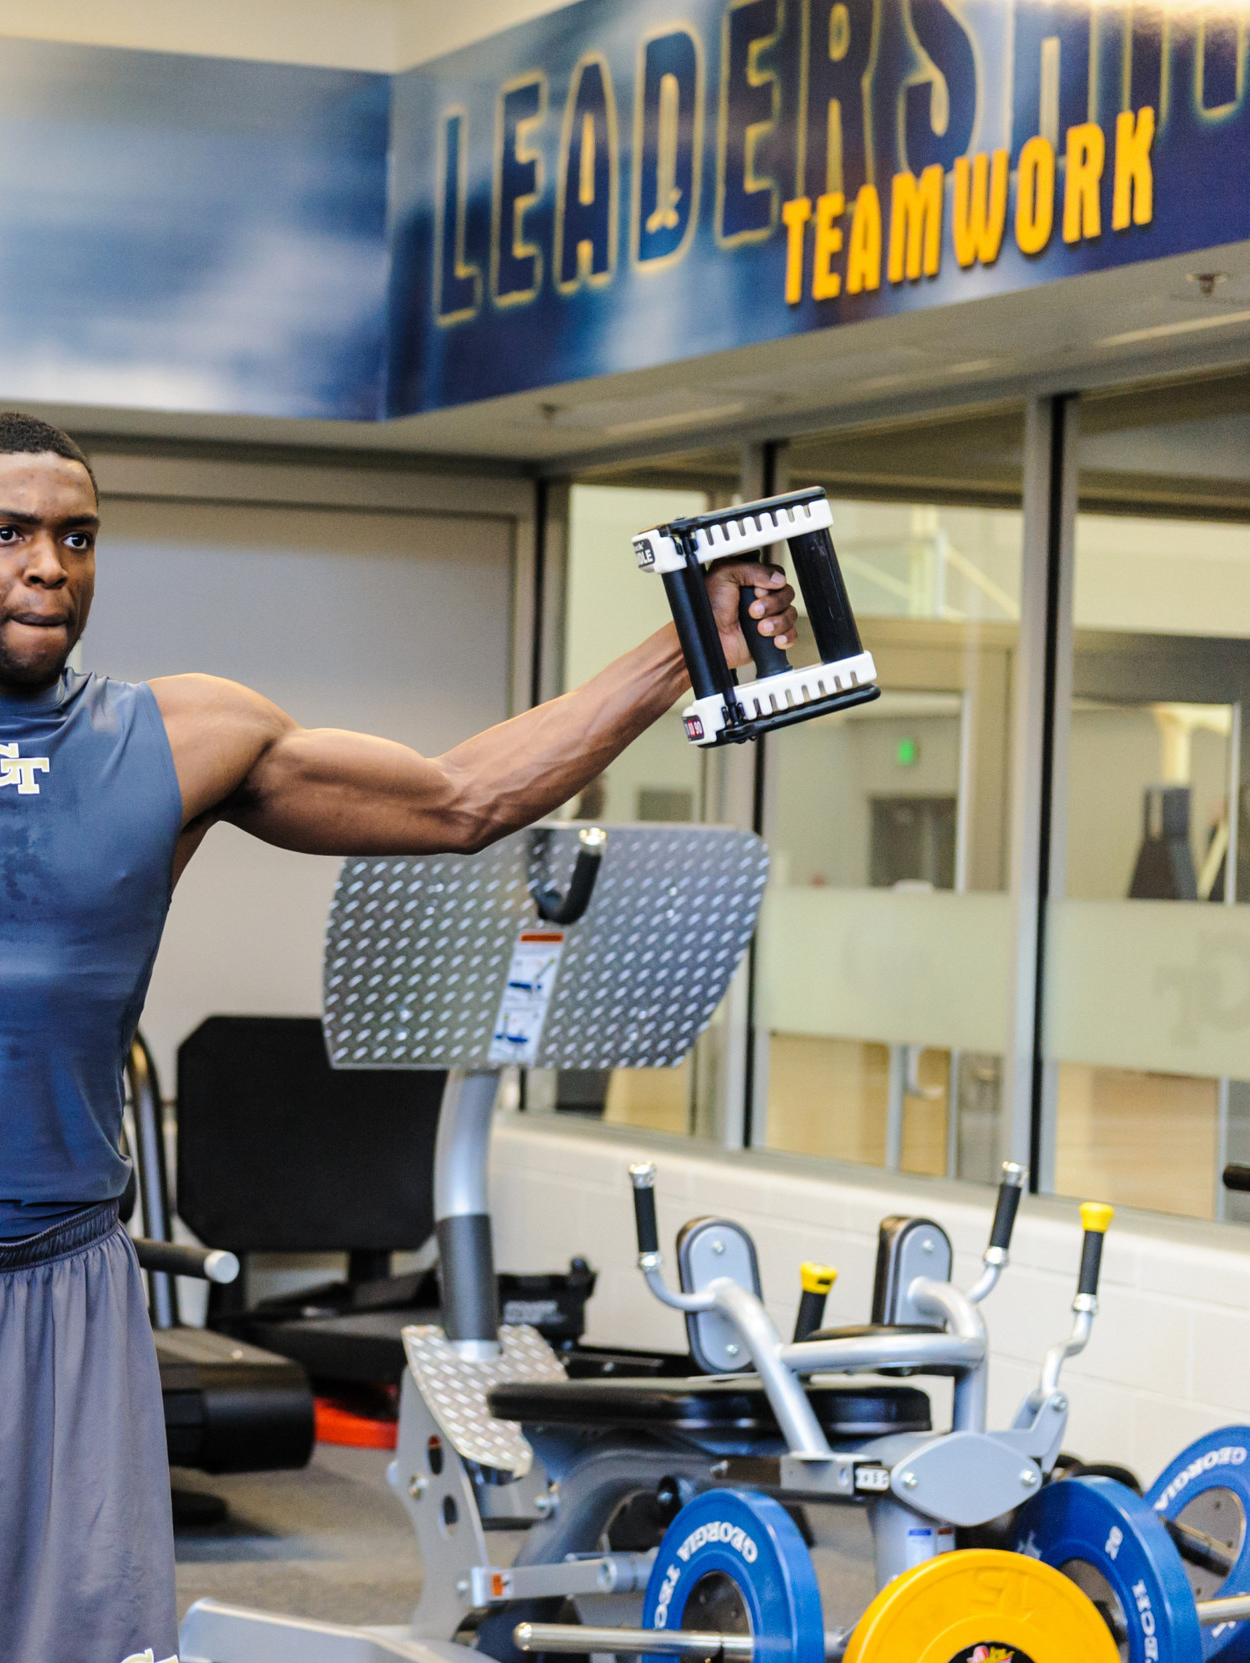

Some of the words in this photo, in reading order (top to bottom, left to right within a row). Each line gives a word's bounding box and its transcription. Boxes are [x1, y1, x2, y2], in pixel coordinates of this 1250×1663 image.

[782, 105, 1155, 305] TEAMWORK
[1153, 1446, 1248, 1511] GEORGIA
[676, 1520, 759, 1563] GEORGIA
[653, 1563, 682, 1630] TEC
[1131, 1578, 1160, 1663] ECH
